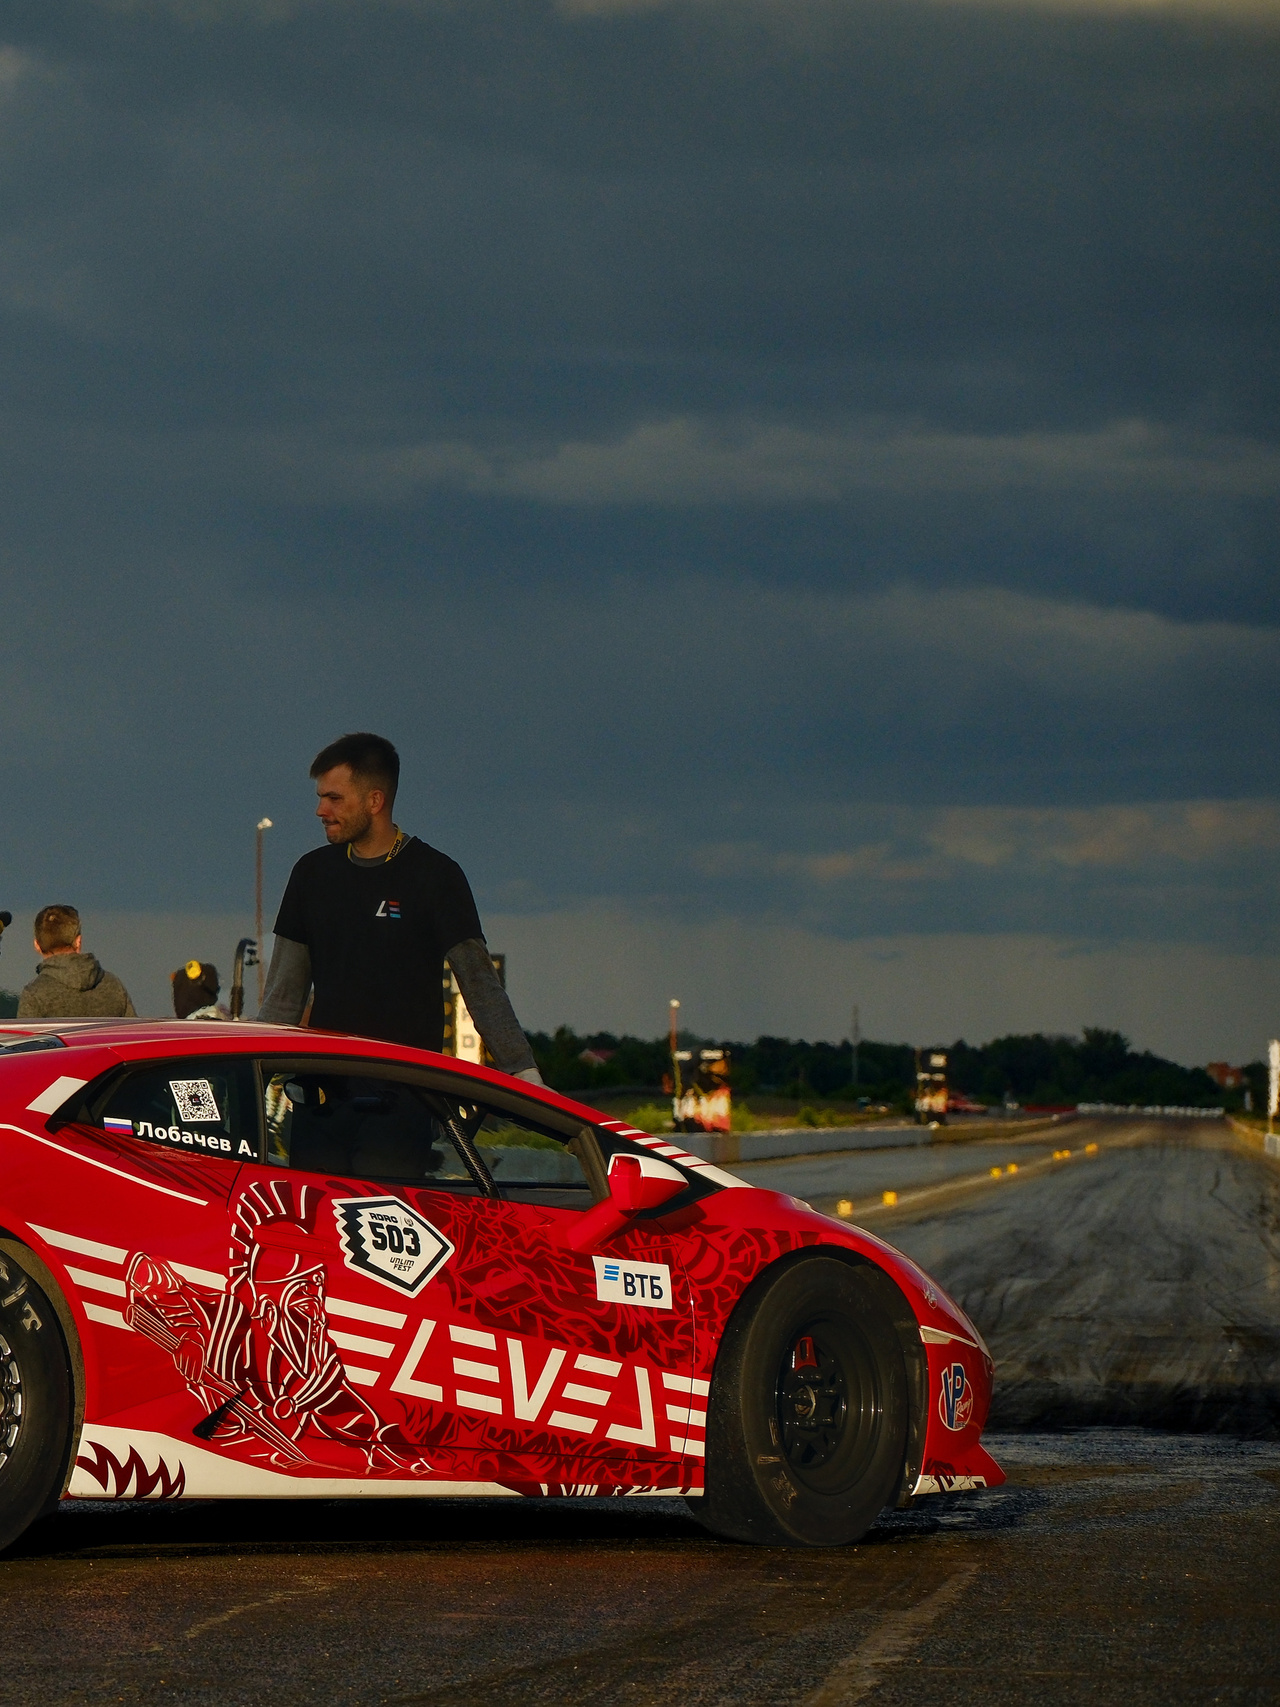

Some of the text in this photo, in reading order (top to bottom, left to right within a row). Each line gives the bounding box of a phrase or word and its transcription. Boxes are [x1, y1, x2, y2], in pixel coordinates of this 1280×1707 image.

[137, 1121, 232, 1152] Лобачев
[368, 1221, 421, 1257] 503
[393, 1264, 412, 1273] FEST
[623, 1272, 664, 1300] ВТБ
[941, 1362, 966, 1429] VP
